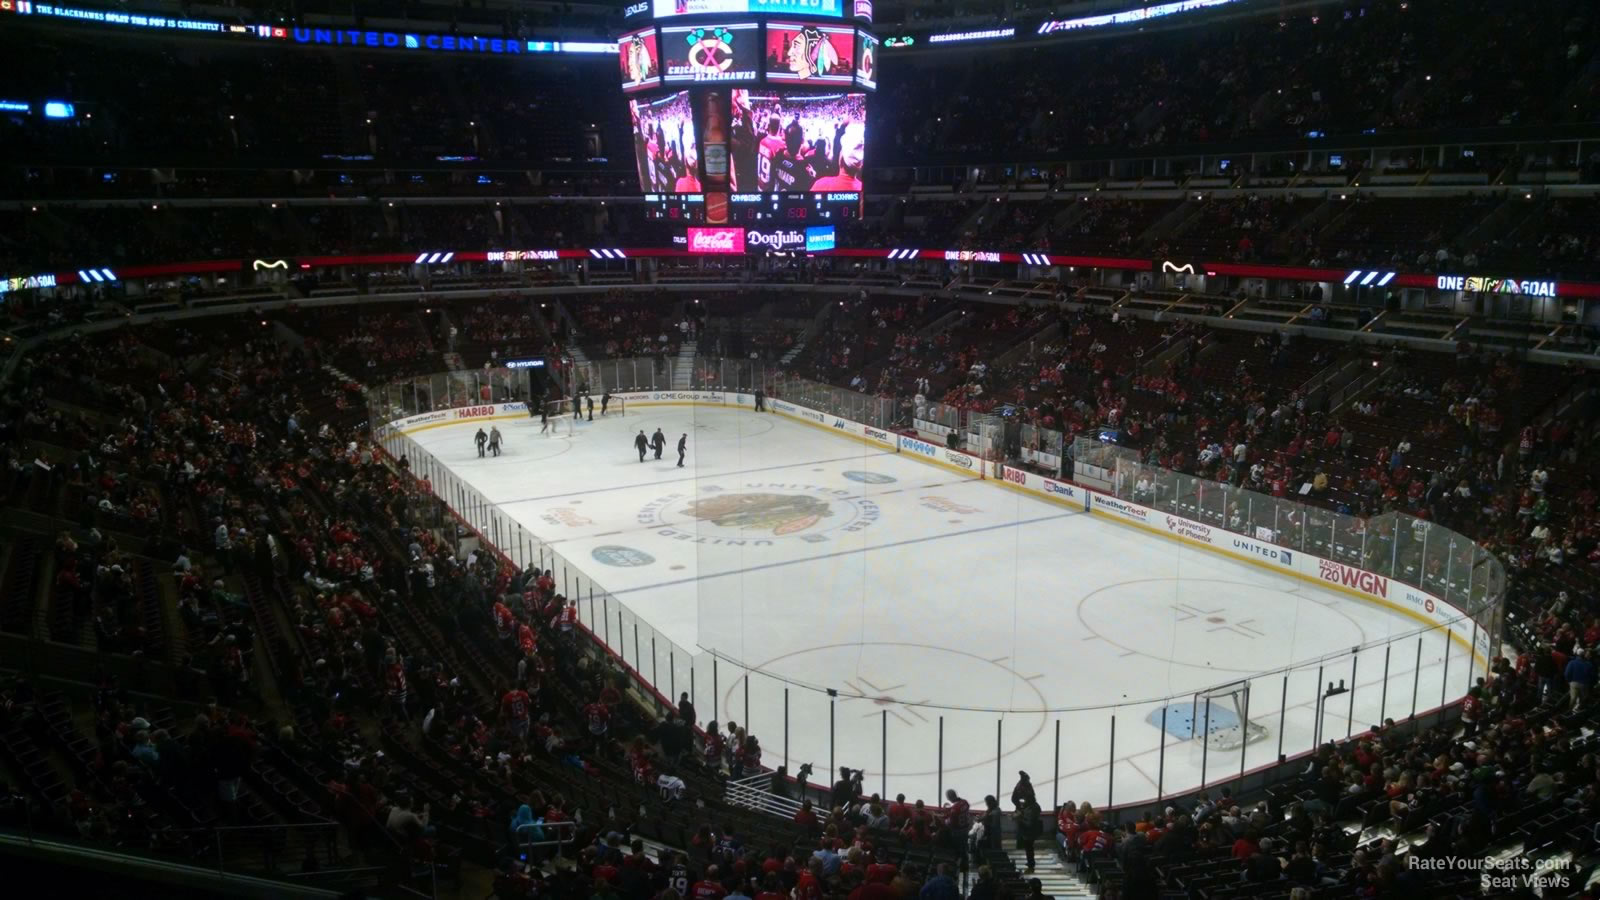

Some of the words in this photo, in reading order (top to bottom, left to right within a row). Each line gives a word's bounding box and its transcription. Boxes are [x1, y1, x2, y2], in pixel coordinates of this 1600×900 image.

[36, 5, 52, 14] THE
[54, 8, 104, 20] BLACKHAWKS
[131, 16, 147, 25] THE
[149, 17, 166, 27] POT
[167, 19, 176, 28] IS
[177, 20, 219, 31] CURRENTLY
[293, 28, 398, 47] UNITED
[425, 35, 521, 53] CENTER
[694, 71, 756, 81] BLACKHAWKS
[827, 193, 859, 201] BLACKHAWKS
[487, 251, 504, 261] ONE
[945, 251, 960, 260] ONE
[1437, 275, 1464, 291] ONE
[1520, 280, 1556, 297] GOAL
[678, 392, 699, 401] Group
[459, 405, 495, 418] HARIBO
[745, 483, 850, 496] UNITED
[1055, 483, 1074, 497] bank
[1094, 495, 1147, 517] WeatherTech
[842, 499, 881, 532] CENTER
[1178, 519, 1211, 536] University
[1177, 527, 1185, 535] of
[1185, 529, 1212, 543] Phoenix
[1233, 538, 1278, 559] UNITED
[1319, 559, 1340, 571] RADIO
[1319, 565, 1340, 583] 720
[1340, 565, 1388, 598] WGN
[1406, 593, 1424, 606] BMO
